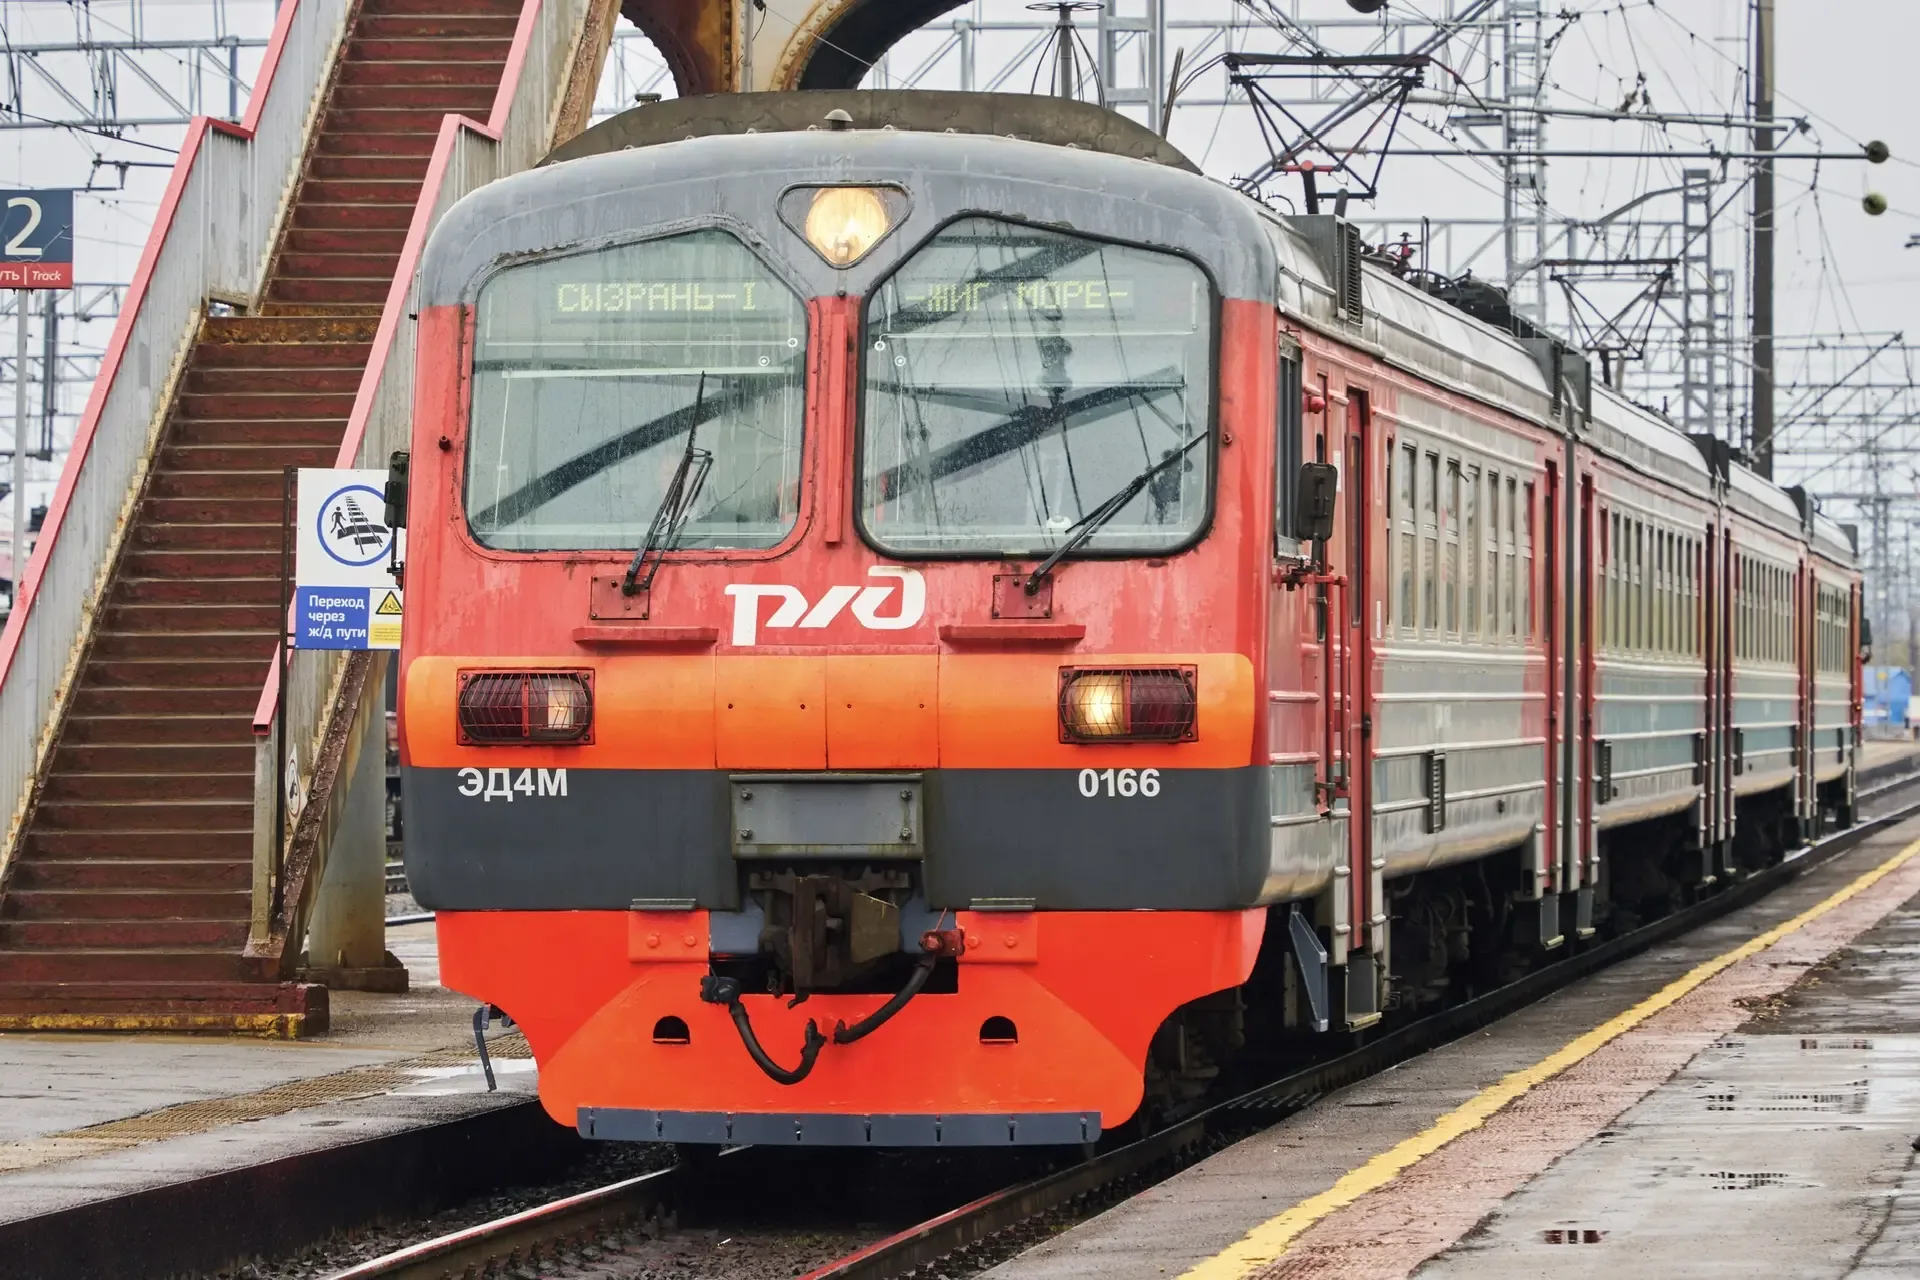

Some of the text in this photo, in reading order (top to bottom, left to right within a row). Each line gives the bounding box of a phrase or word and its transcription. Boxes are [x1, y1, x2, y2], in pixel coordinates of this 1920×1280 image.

[5, 197, 42, 255] 2
[32, 270, 62, 281] Track
[309, 594, 365, 610] Переход
[308, 612, 345, 625] через
[308, 625, 332, 639] ж/д
[336, 628, 366, 640] пути
[457, 767, 568, 802] ЭД4М
[1078, 768, 1160, 797] 0166
